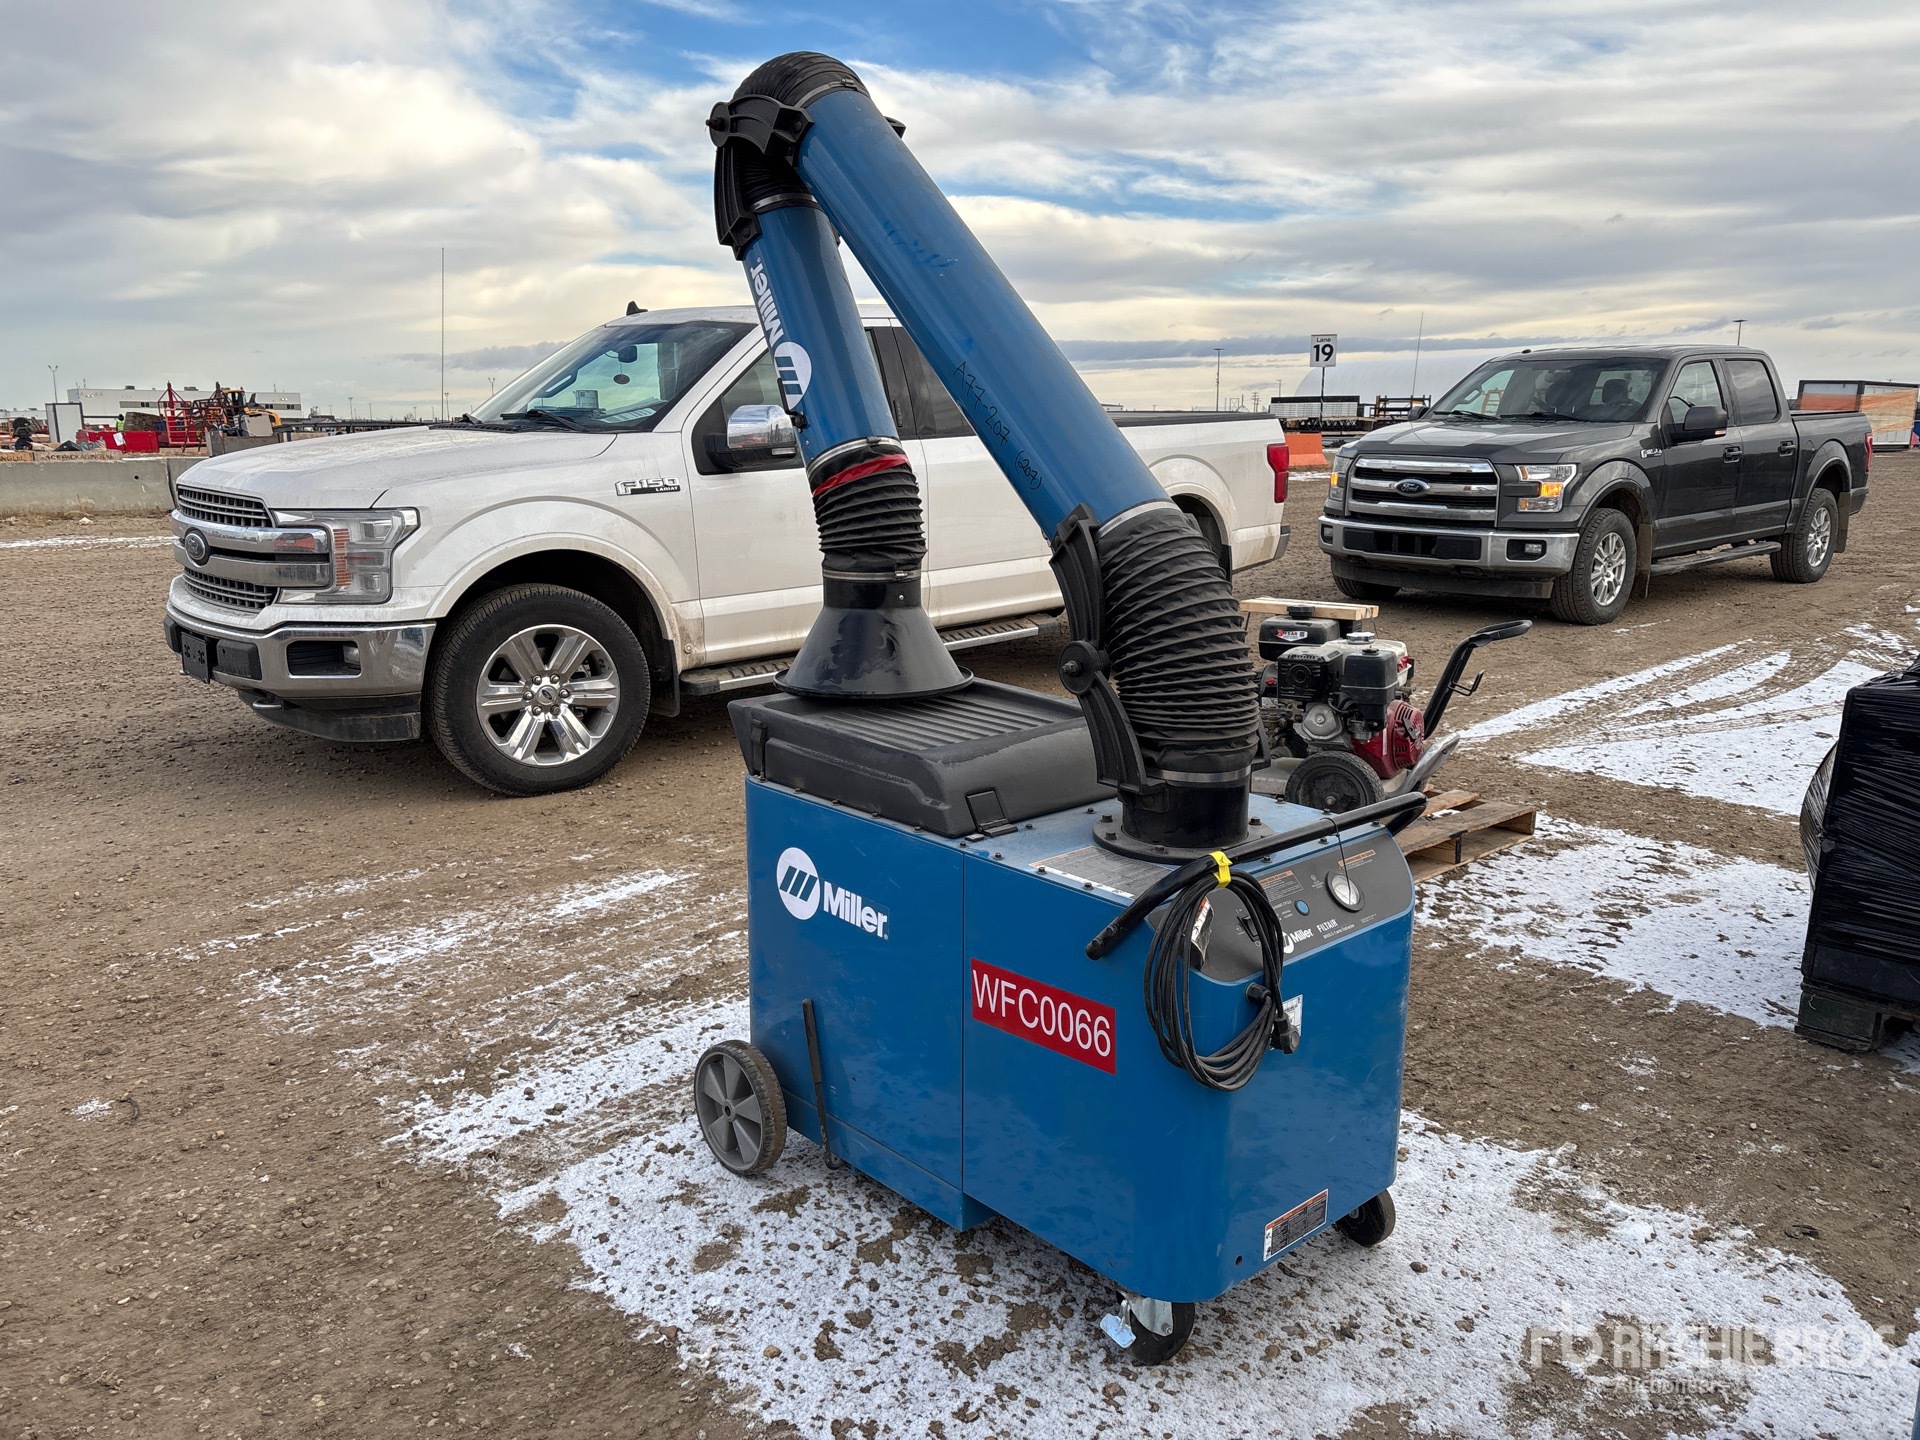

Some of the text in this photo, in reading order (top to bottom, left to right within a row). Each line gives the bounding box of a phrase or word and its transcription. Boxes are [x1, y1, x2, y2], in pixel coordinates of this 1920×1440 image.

[1313, 343, 1334, 362] 19
[952, 360, 1011, 447] A77-207
[1400, 482, 1419, 492] Ford
[1316, 918, 1337, 933] FILTAIR
[1290, 928, 1313, 944] Miller
[972, 969, 1112, 1057] WFC0066
